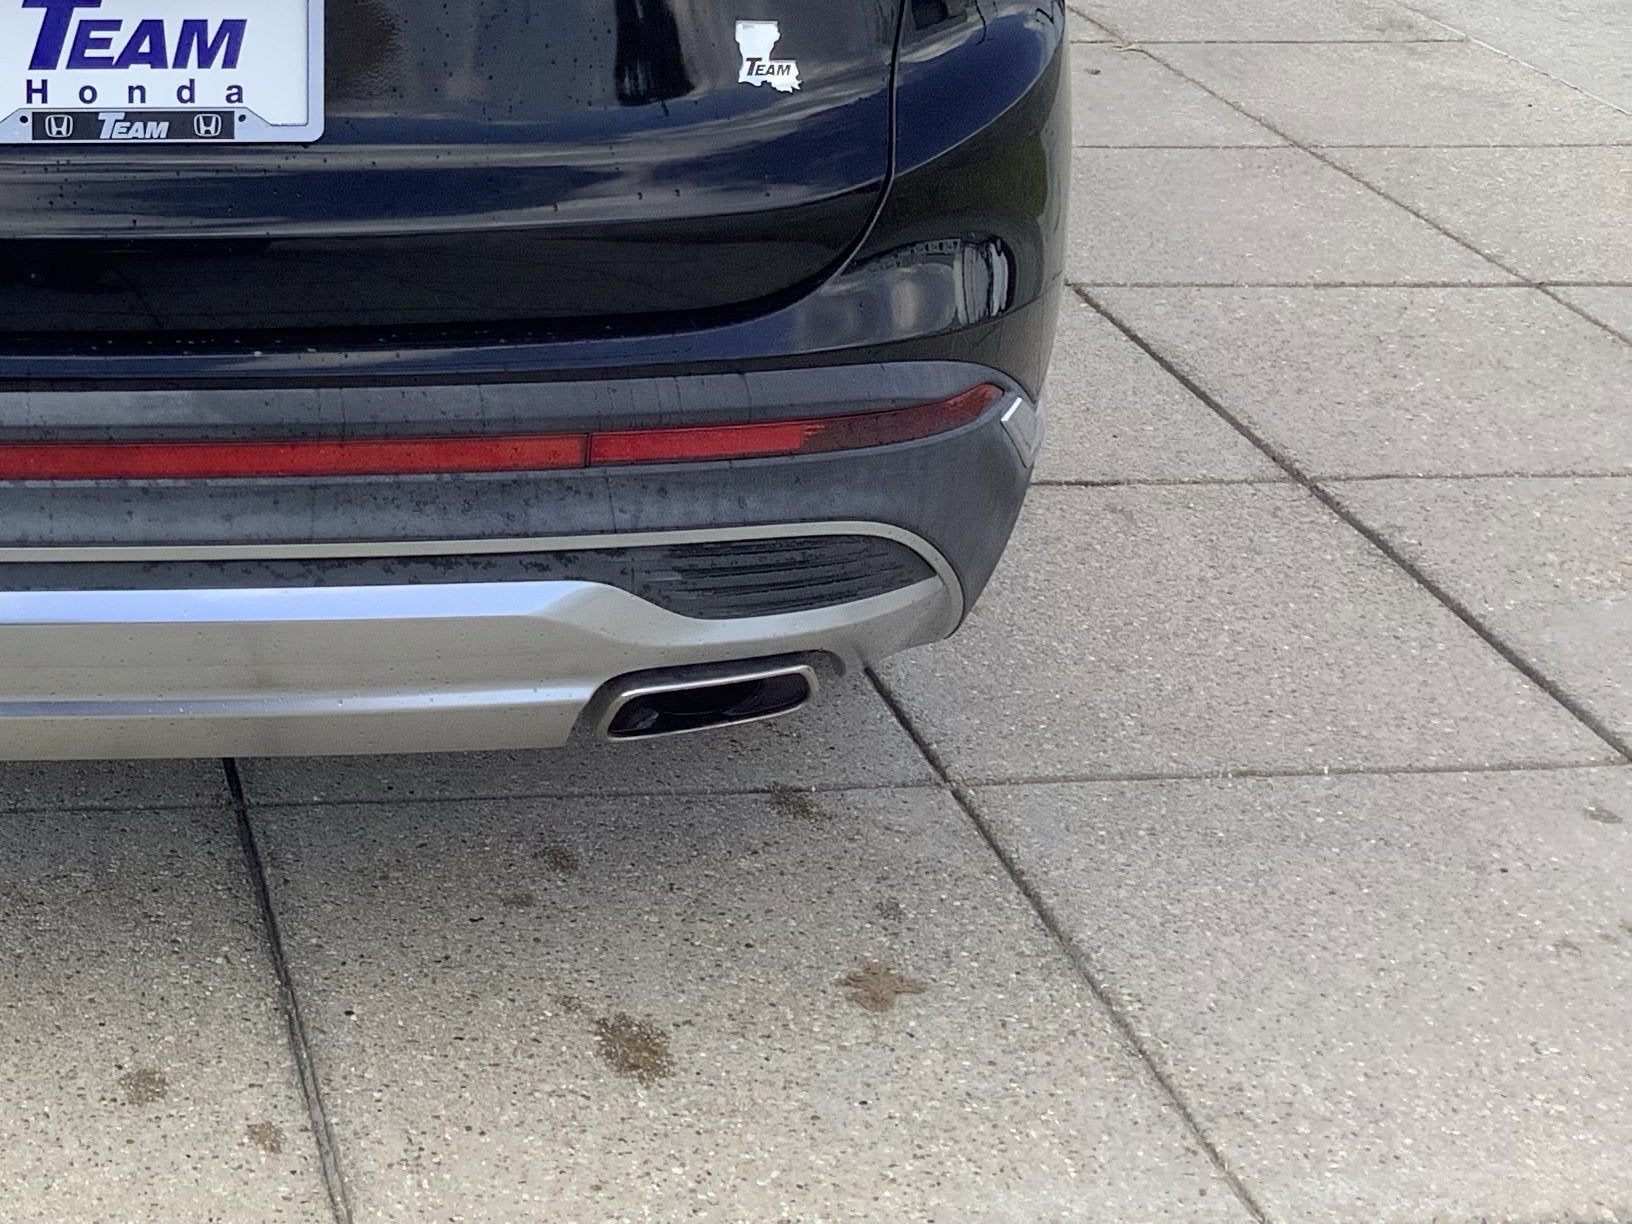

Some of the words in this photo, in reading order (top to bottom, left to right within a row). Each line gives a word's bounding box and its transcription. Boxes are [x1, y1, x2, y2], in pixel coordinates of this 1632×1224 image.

[745, 57, 791, 77] TEAM
[25, 79, 244, 105] Honda
[97, 112, 170, 139] TEAM
